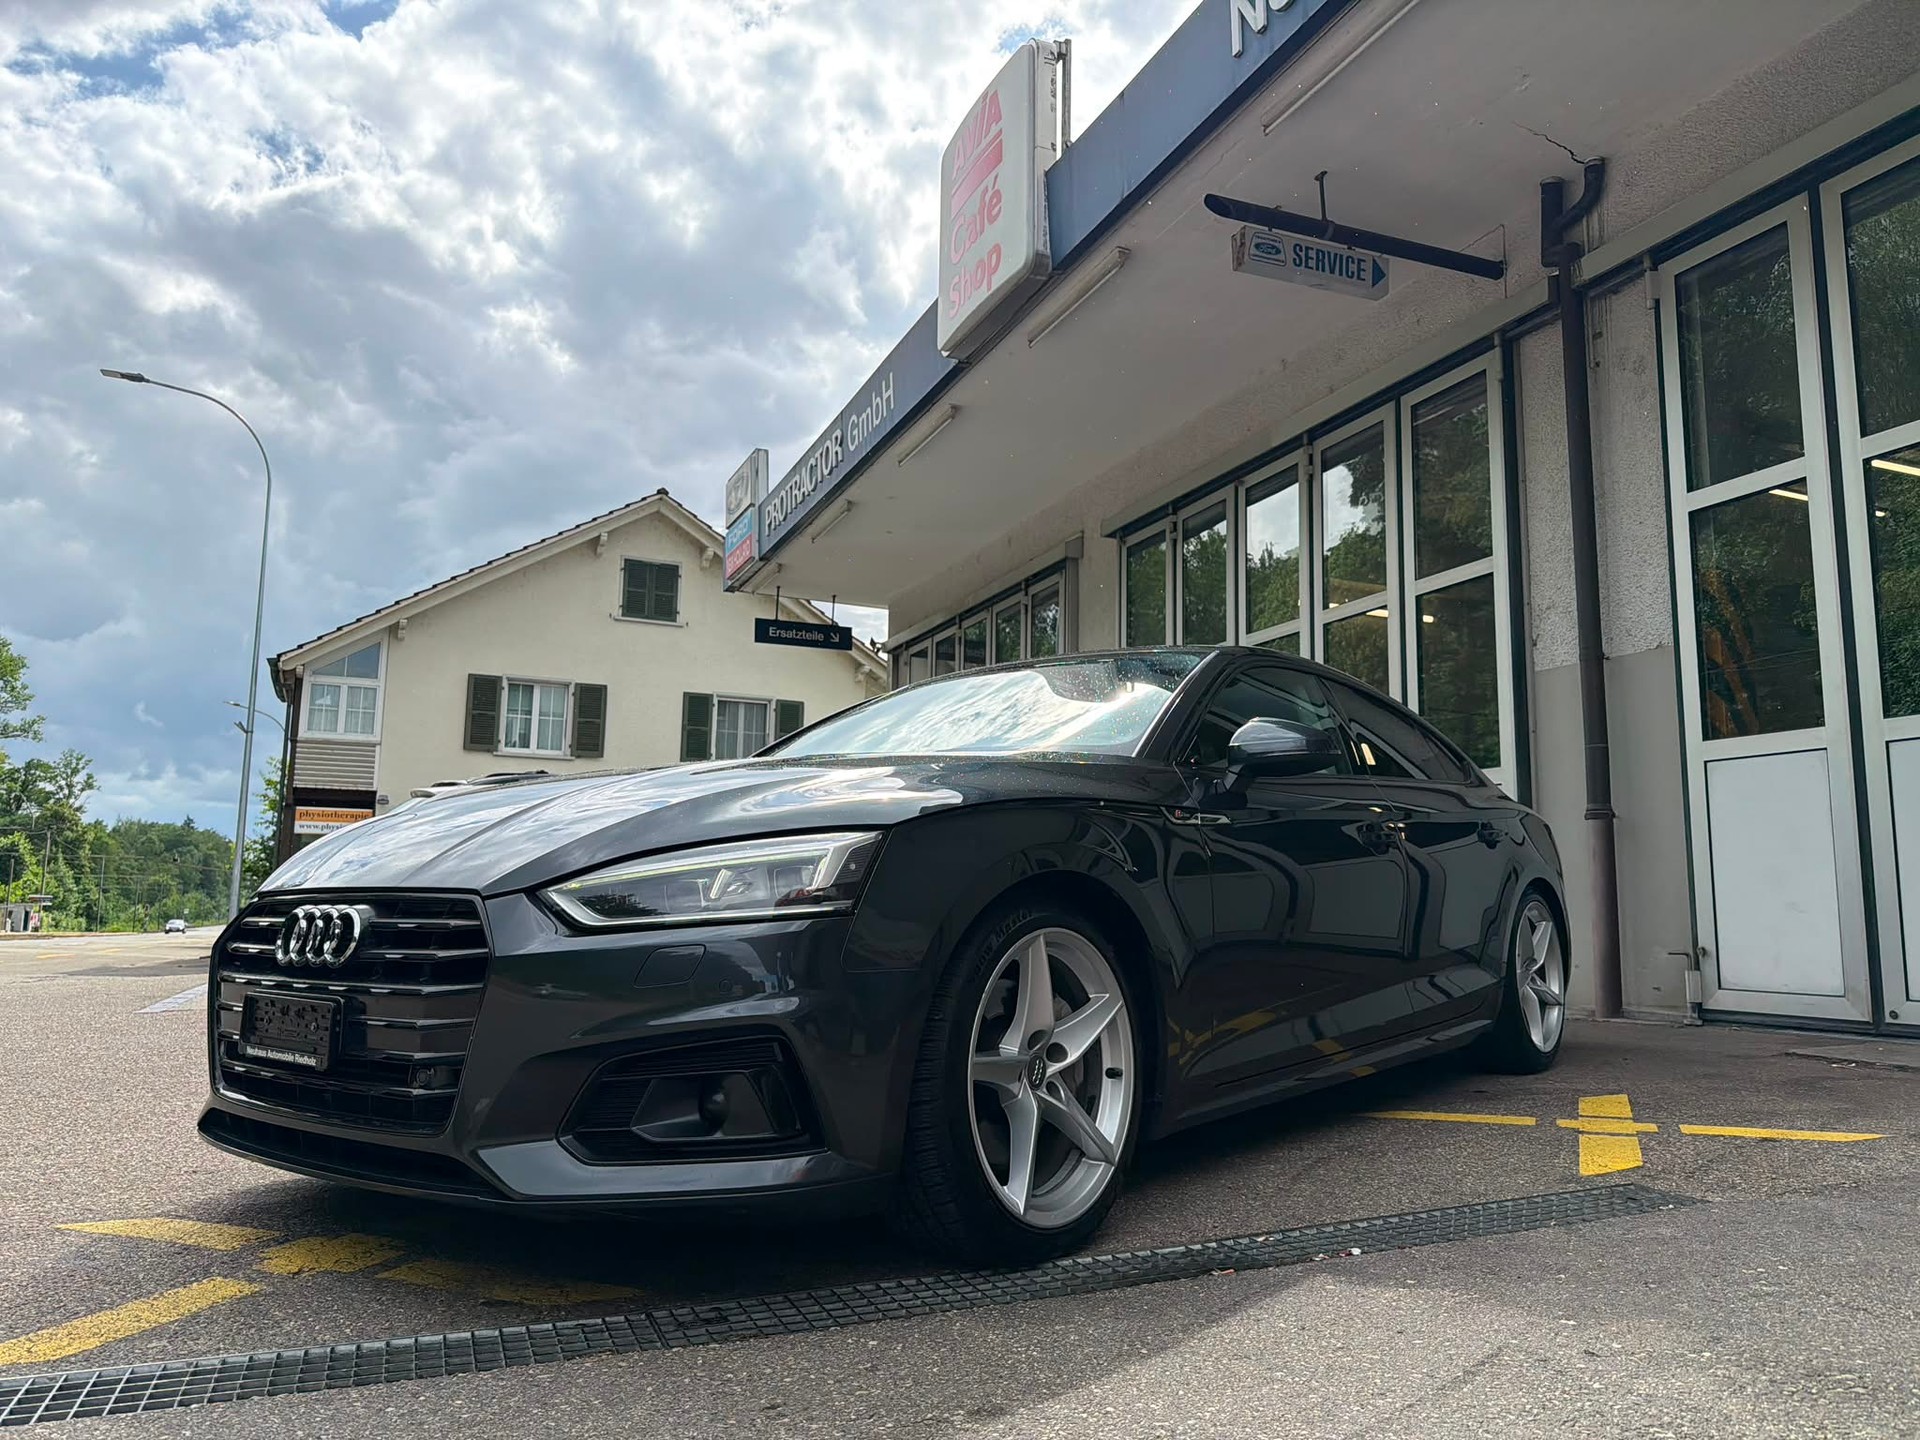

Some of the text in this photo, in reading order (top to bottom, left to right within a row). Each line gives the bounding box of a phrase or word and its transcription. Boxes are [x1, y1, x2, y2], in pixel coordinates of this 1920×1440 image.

[951, 172, 1002, 265] Café
[950, 243, 1002, 319] Shop
[1293, 243, 1366, 281] SERVICE
[765, 371, 894, 536] PROTRACTOR GmbH
[768, 626, 825, 642] Ersatzteile
[299, 809, 371, 820] physiotherapie
[246, 1045, 317, 1066] Neuhaus Automobile Riedholz
